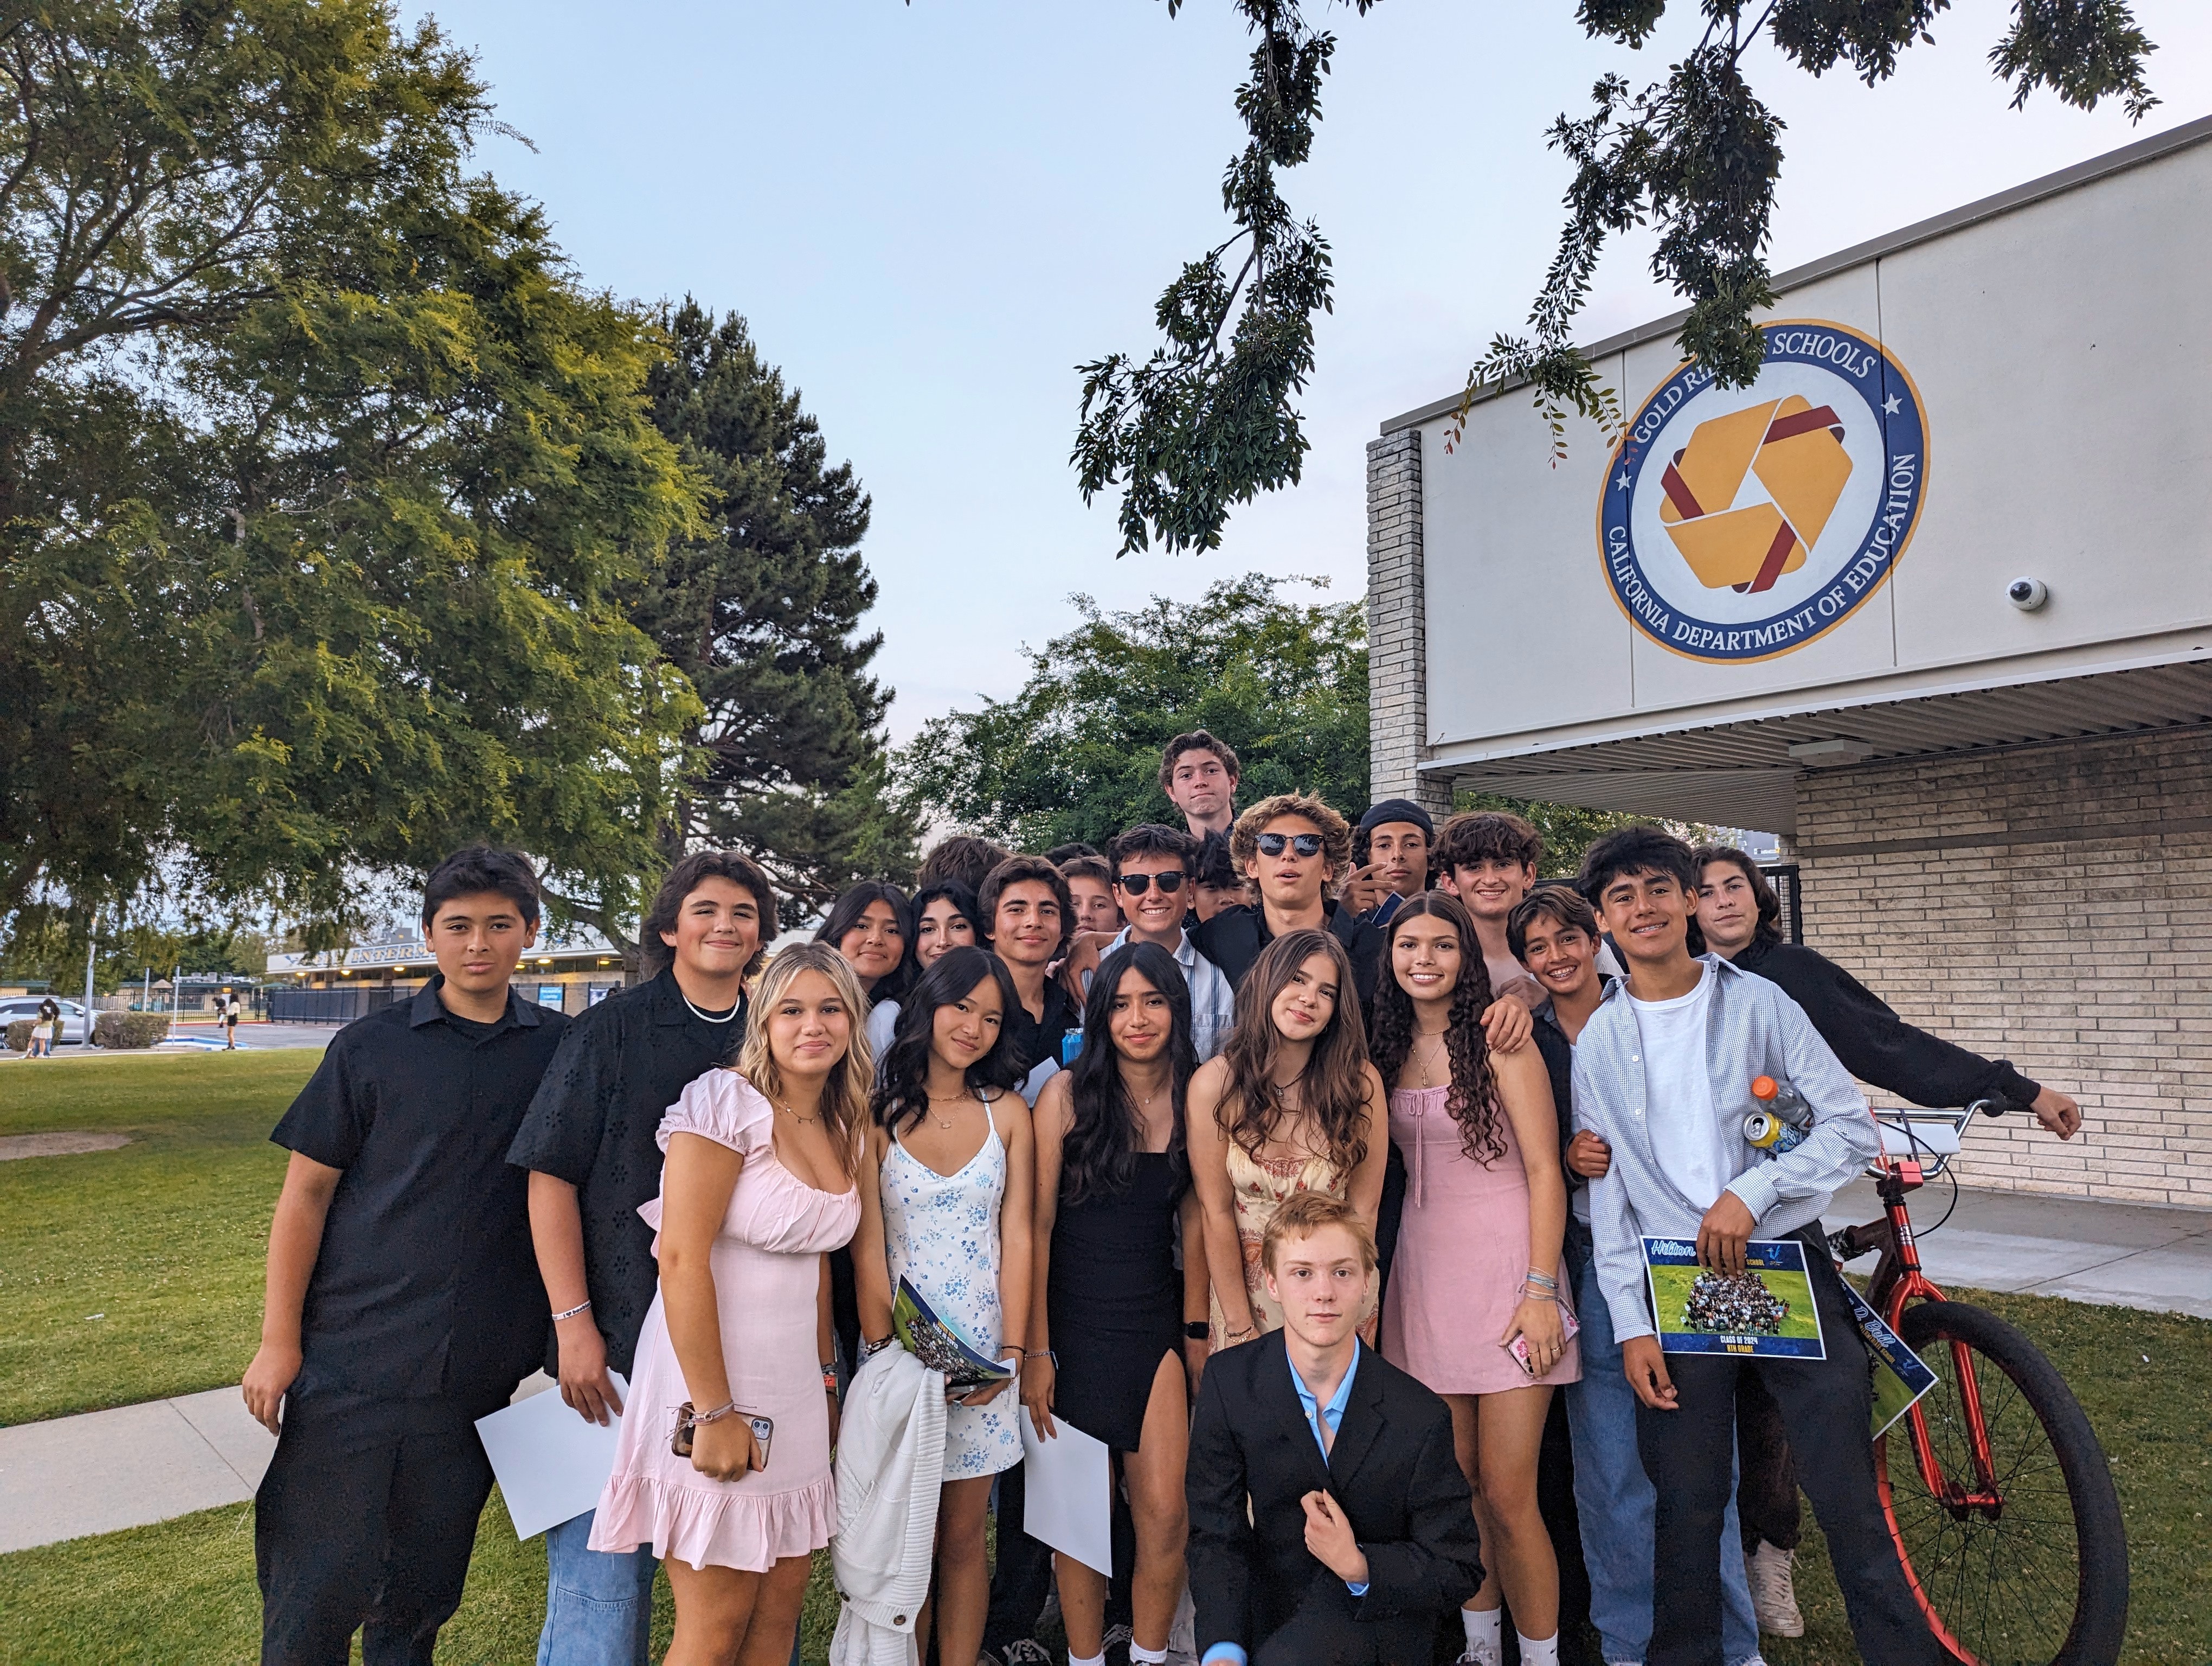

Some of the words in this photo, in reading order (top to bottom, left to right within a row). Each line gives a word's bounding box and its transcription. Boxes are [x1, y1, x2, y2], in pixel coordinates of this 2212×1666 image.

[1634, 386, 1683, 444] GOLD
[1772, 332, 1877, 379] SCHOOLS
[1609, 525, 1670, 634] CALIFORNIA
[1671, 605, 1817, 651] DEPARTMENT
[1818, 585, 1847, 616] OF
[1842, 453, 1915, 594] EDUCATION
[1651, 1240, 1696, 1257] Hilton
[1720, 1335, 1736, 1344] CLASS
[1737, 1336, 1743, 1344] OF
[1744, 1336, 1758, 1345] 2024
[1854, 1306, 1868, 1321] D.
[1864, 1319, 1896, 1348] Bell
[1727, 1344, 1737, 1353] 8TH
[1737, 1344, 1754, 1354] GRADE
